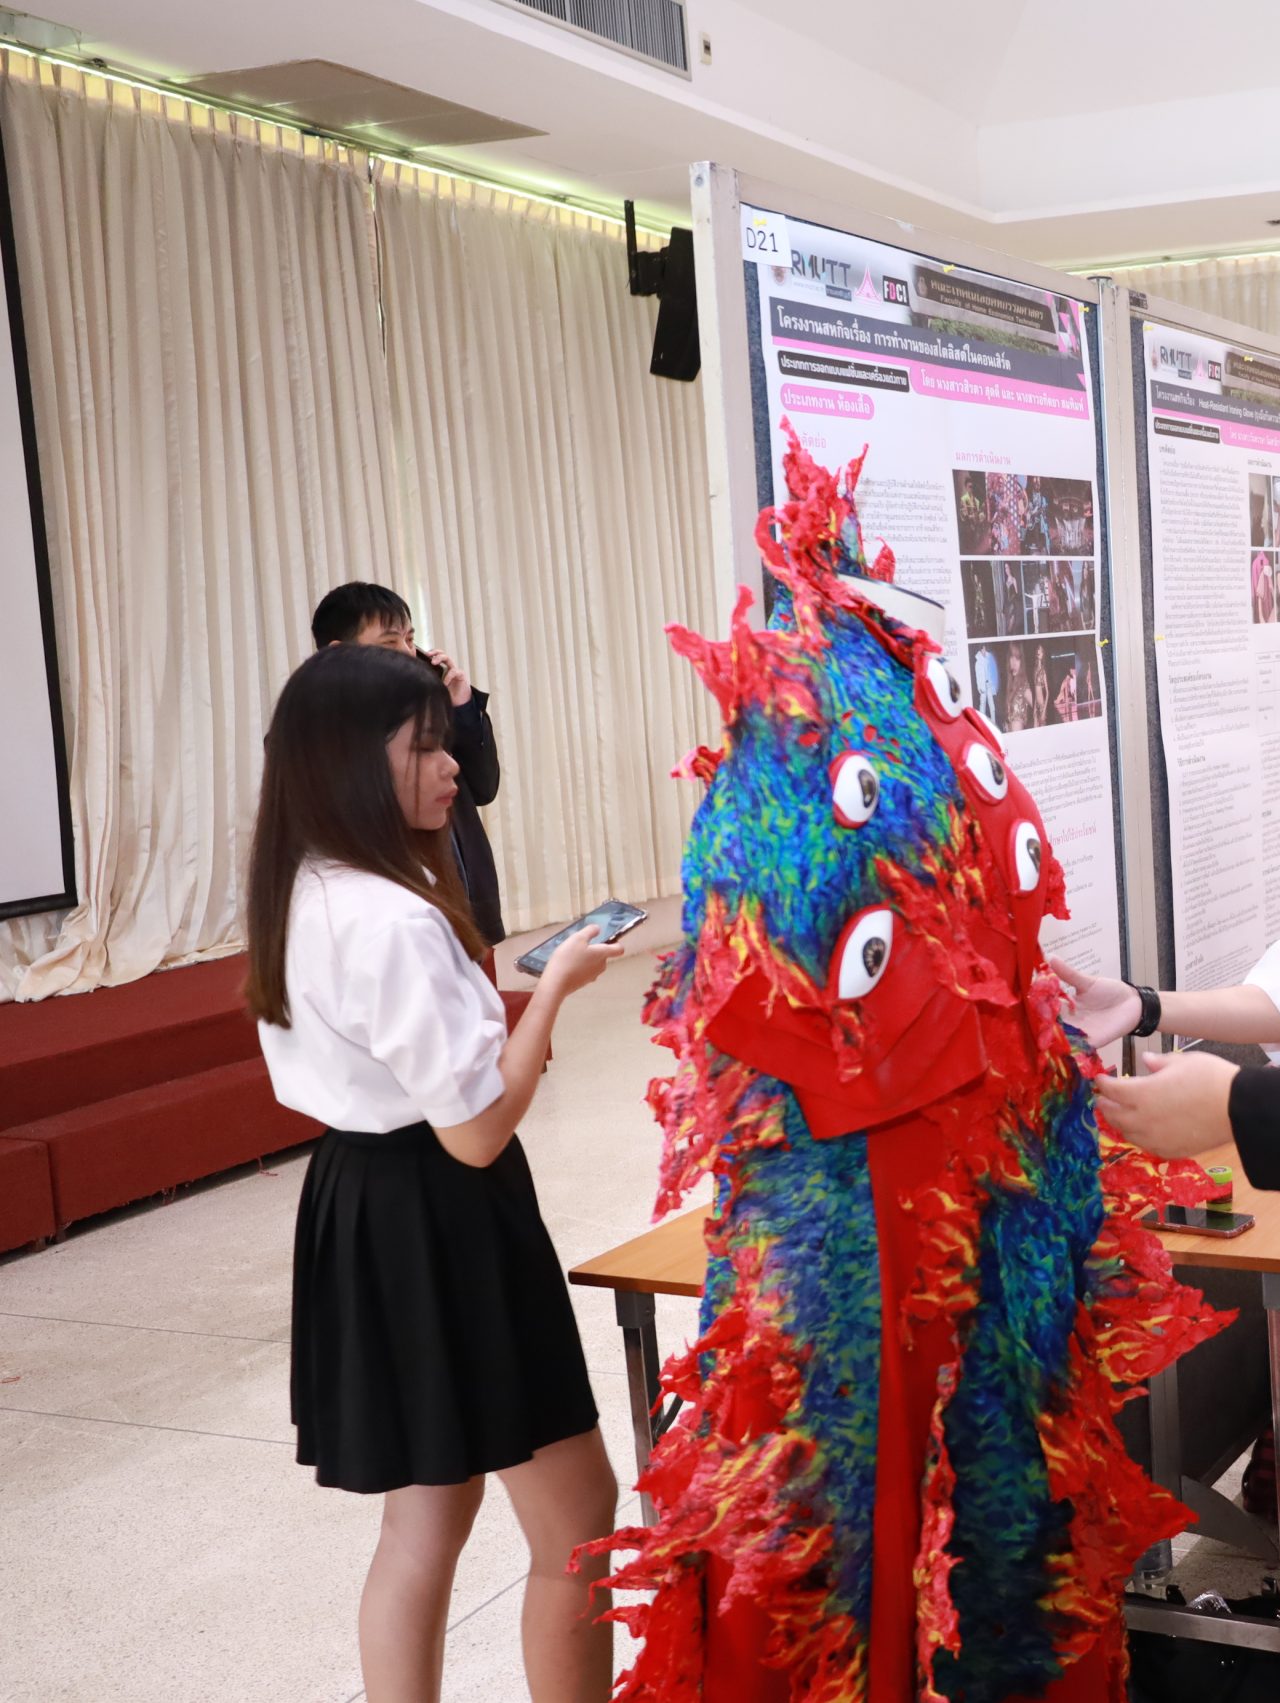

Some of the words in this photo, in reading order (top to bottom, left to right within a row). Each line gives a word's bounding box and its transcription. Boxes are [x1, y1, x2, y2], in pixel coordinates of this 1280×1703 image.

[746, 227, 778, 252] D21
[884, 280, 908, 303] FDCI
[776, 305, 871, 344] โครงงานสหกิจเรื่อง
[783, 388, 835, 410] ประเภทงาน
[837, 391, 870, 414] ห้องเสื้อ
[800, 431, 827, 449] คัดย่อ
